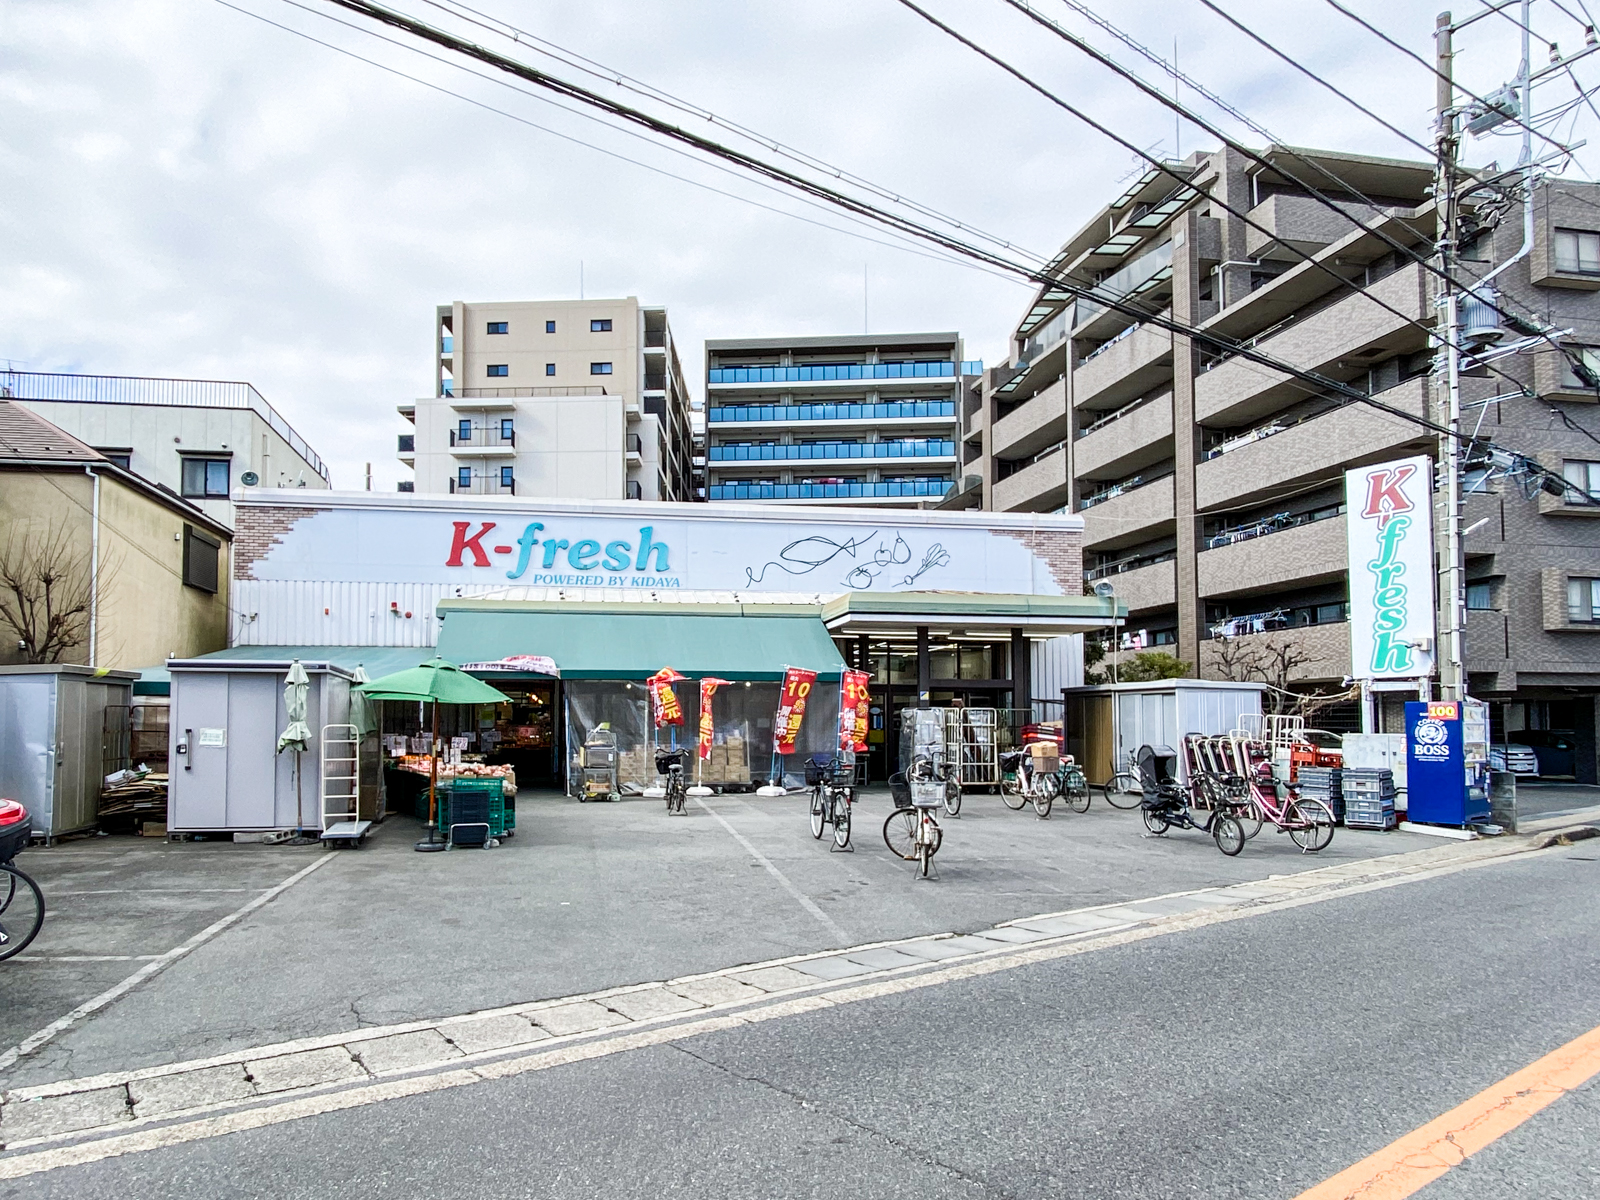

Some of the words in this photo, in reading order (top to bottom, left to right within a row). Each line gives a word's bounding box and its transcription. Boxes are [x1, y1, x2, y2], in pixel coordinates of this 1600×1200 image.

[445, 521, 670, 580] K-fresh
[533, 574, 604, 586] POWERED
[608, 576, 628, 586] BY
[631, 576, 681, 588] KIDAYA
[788, 681, 811, 698] 10
[847, 683, 869, 700] 10
[1430, 706, 1455, 717] 100
[782, 714, 803, 744] 還元
[1414, 744, 1450, 756] BOSS
